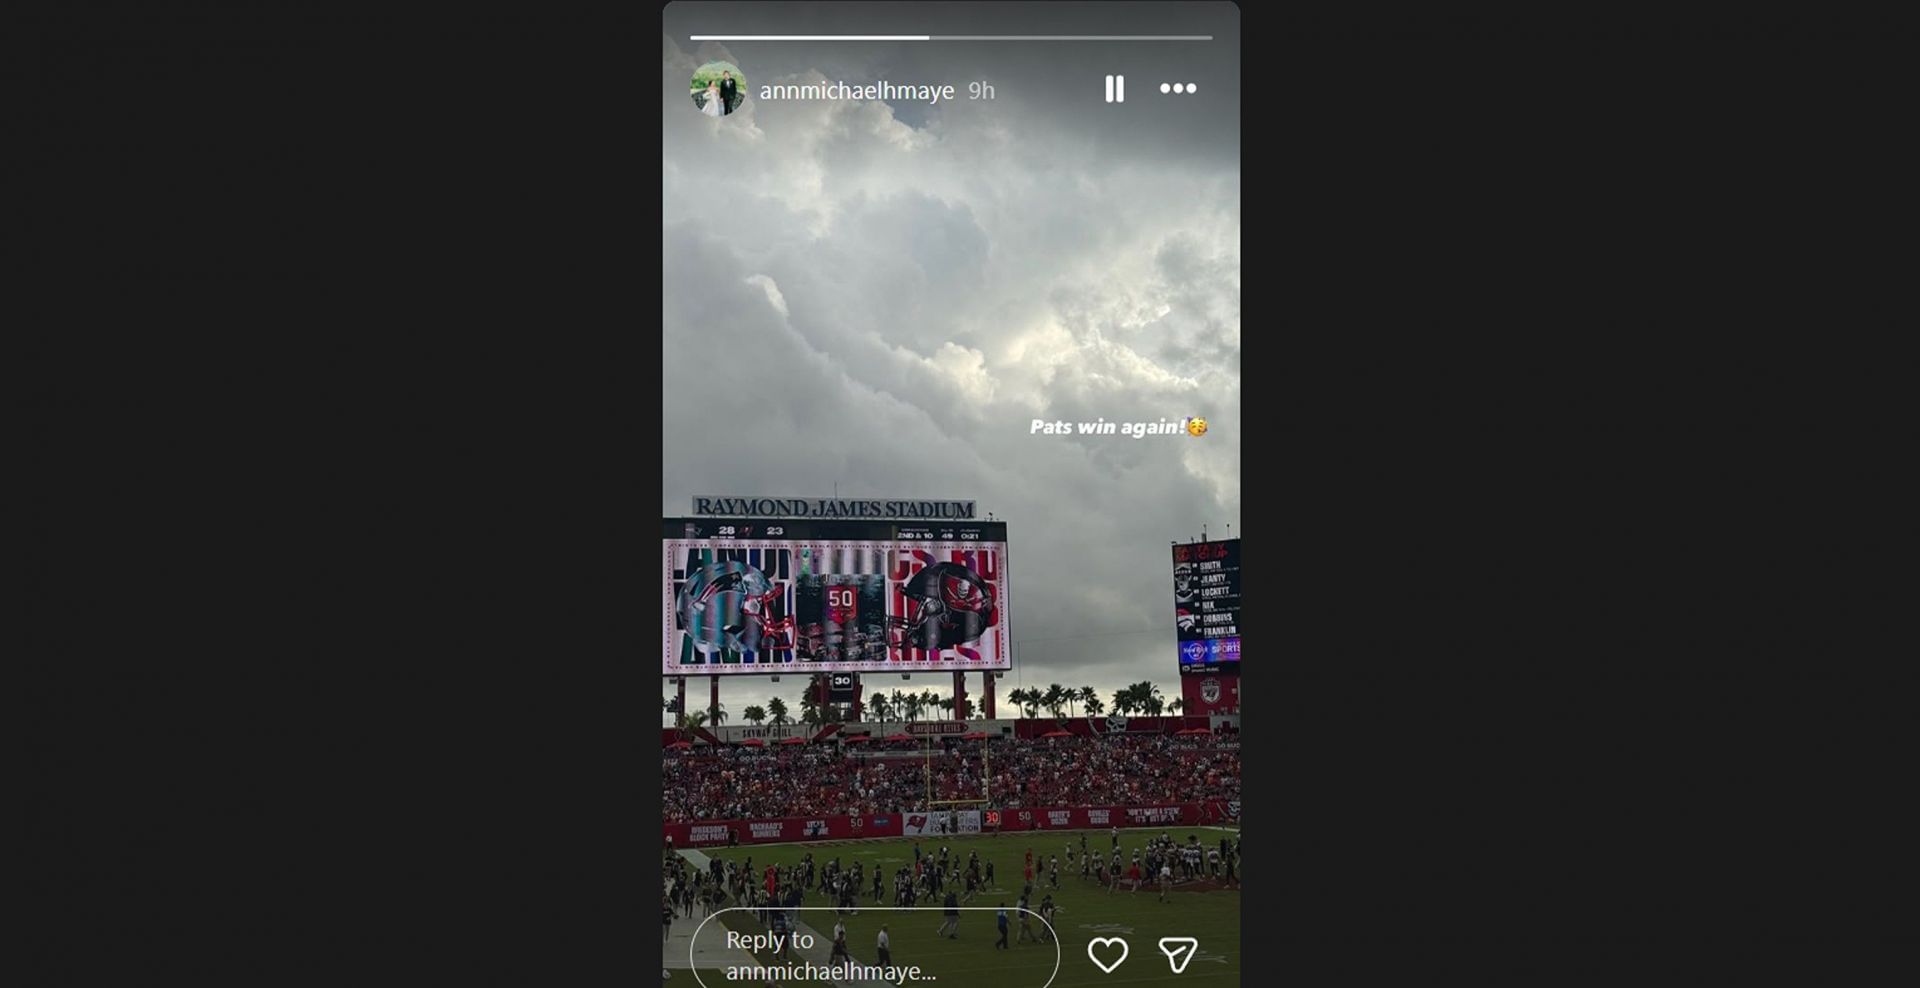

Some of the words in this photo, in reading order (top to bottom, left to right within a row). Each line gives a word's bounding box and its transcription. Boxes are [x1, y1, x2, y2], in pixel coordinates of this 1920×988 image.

[696, 498, 808, 516] RAYMOND
[812, 499, 882, 518] JAMES
[886, 501, 974, 519] STADIUM
[718, 526, 736, 535] 28
[766, 526, 784, 536] 23
[897, 532, 915, 540] 2ND
[923, 532, 934, 540] 10
[941, 532, 954, 540] 49
[960, 532, 980, 540] 0:21
[1200, 574, 1226, 584] JEANTY
[1201, 586, 1229, 597] LOCKETT
[829, 590, 852, 607] 50
[1204, 625, 1236, 636] FRANKLIN
[834, 676, 851, 685] 30
[985, 811, 999, 823] 30
[1018, 811, 1031, 821] 50
[850, 818, 864, 828] 50
